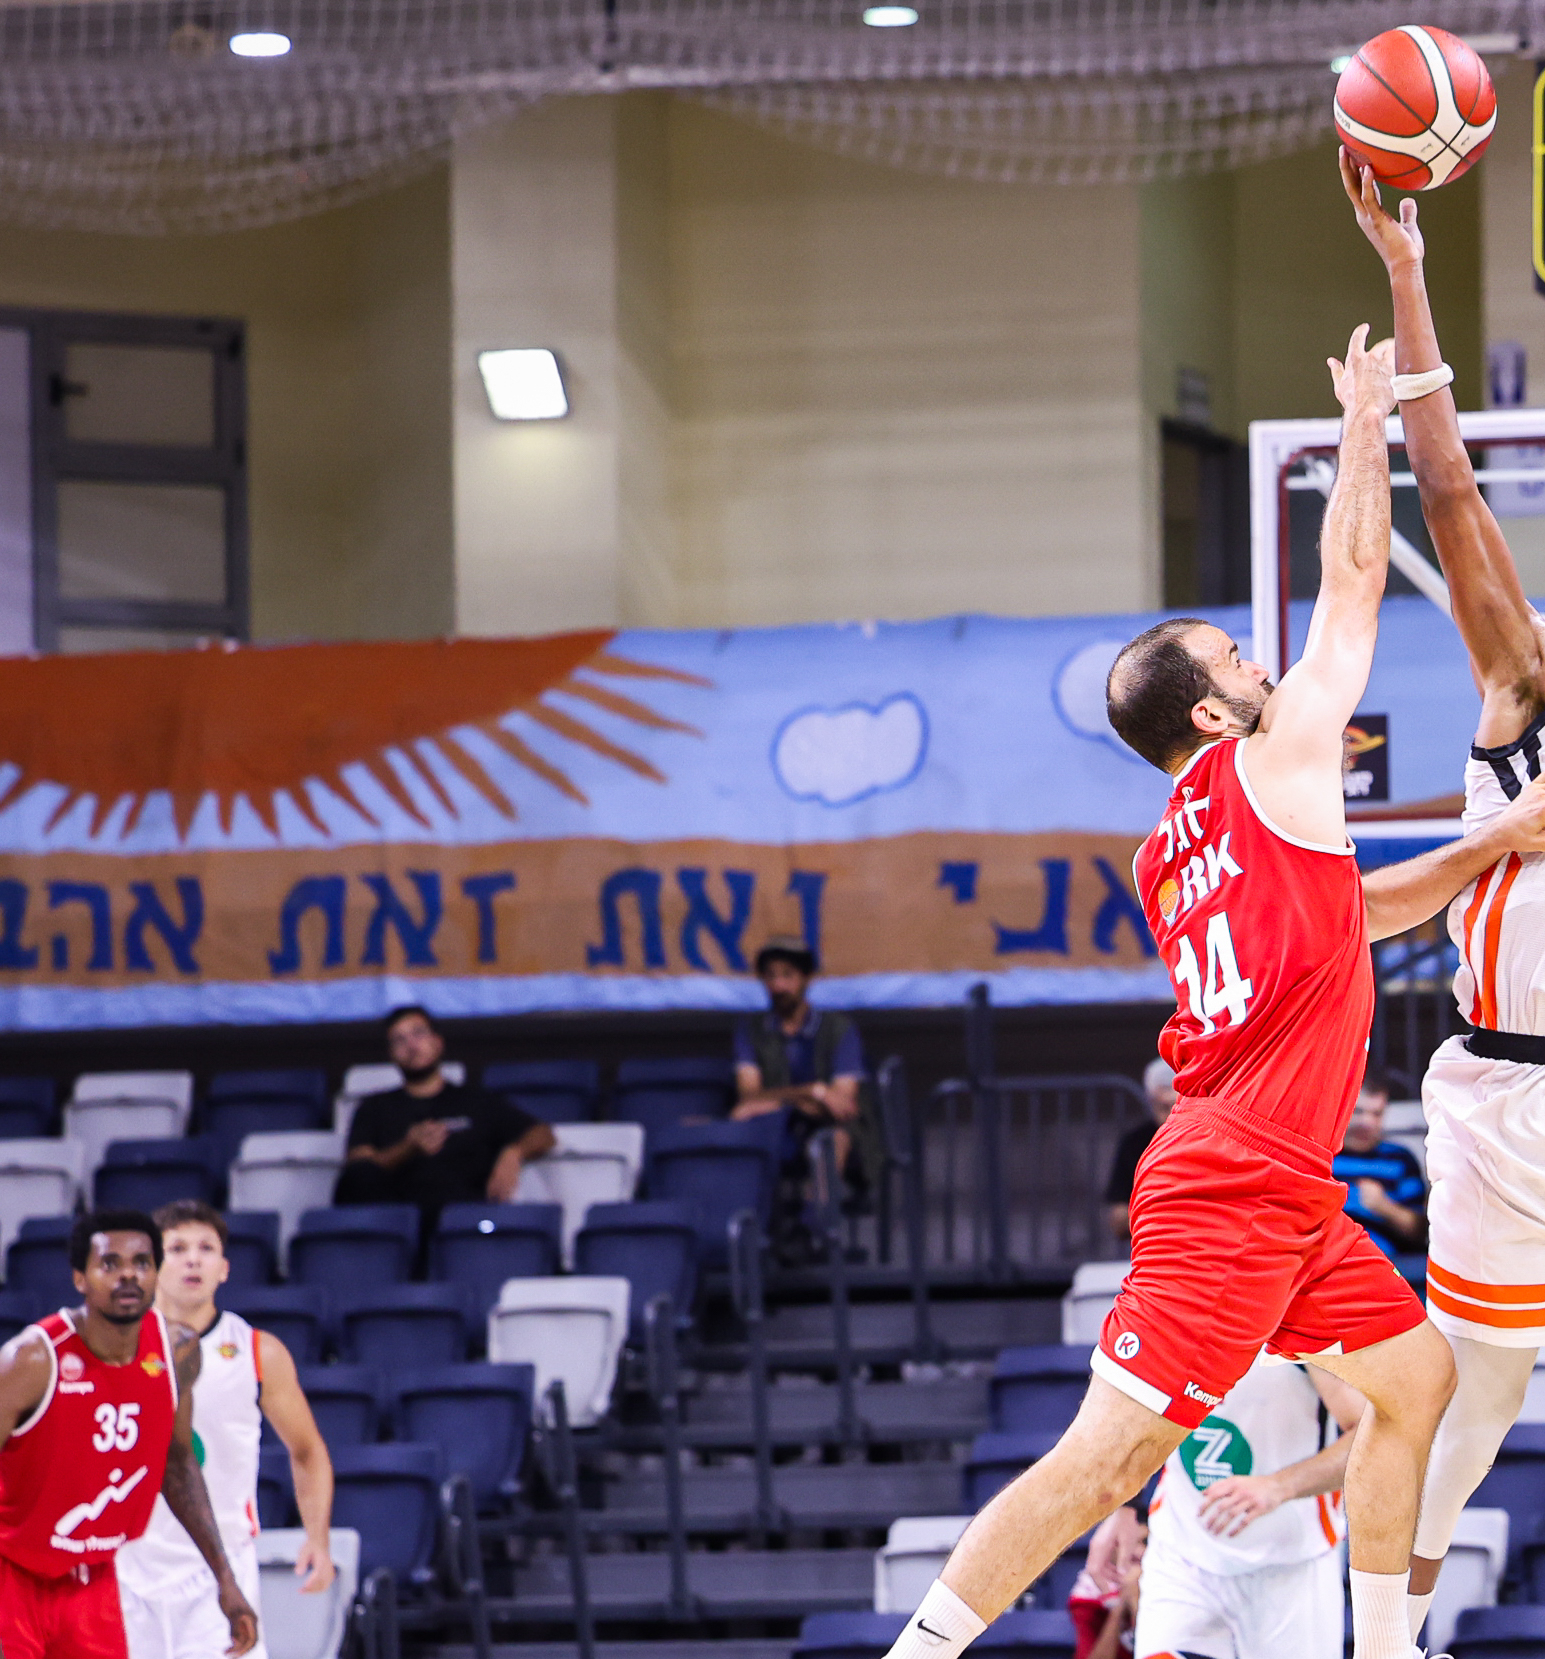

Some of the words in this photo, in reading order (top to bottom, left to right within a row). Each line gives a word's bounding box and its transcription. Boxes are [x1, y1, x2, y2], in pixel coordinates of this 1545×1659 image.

[267, 867, 518, 977] זאת
[1174, 910, 1253, 1037] 14
[92, 1402, 142, 1453] 35
